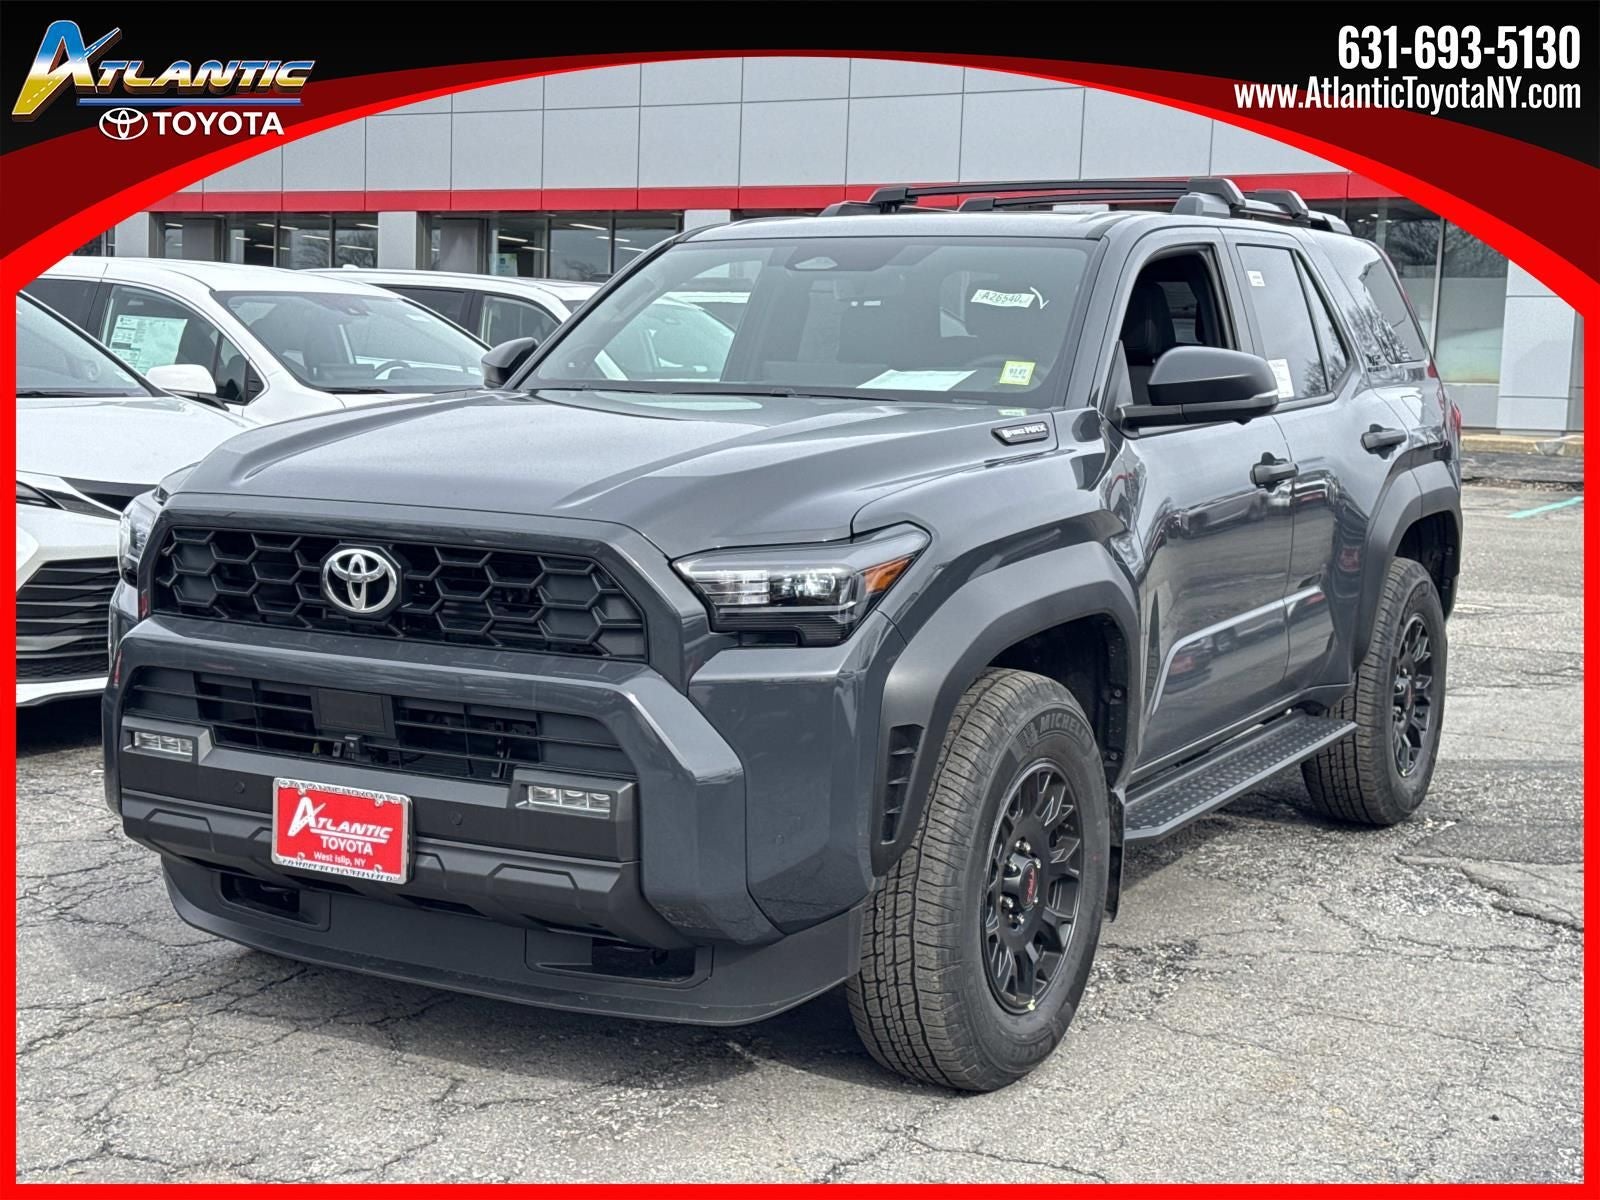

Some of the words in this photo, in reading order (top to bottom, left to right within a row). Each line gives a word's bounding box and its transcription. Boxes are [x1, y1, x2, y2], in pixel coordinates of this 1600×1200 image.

[287, 796, 393, 838] ATLANTIC
[320, 836, 373, 856] TOYOTA
[313, 851, 333, 862] West
[354, 857, 367, 867] NY
